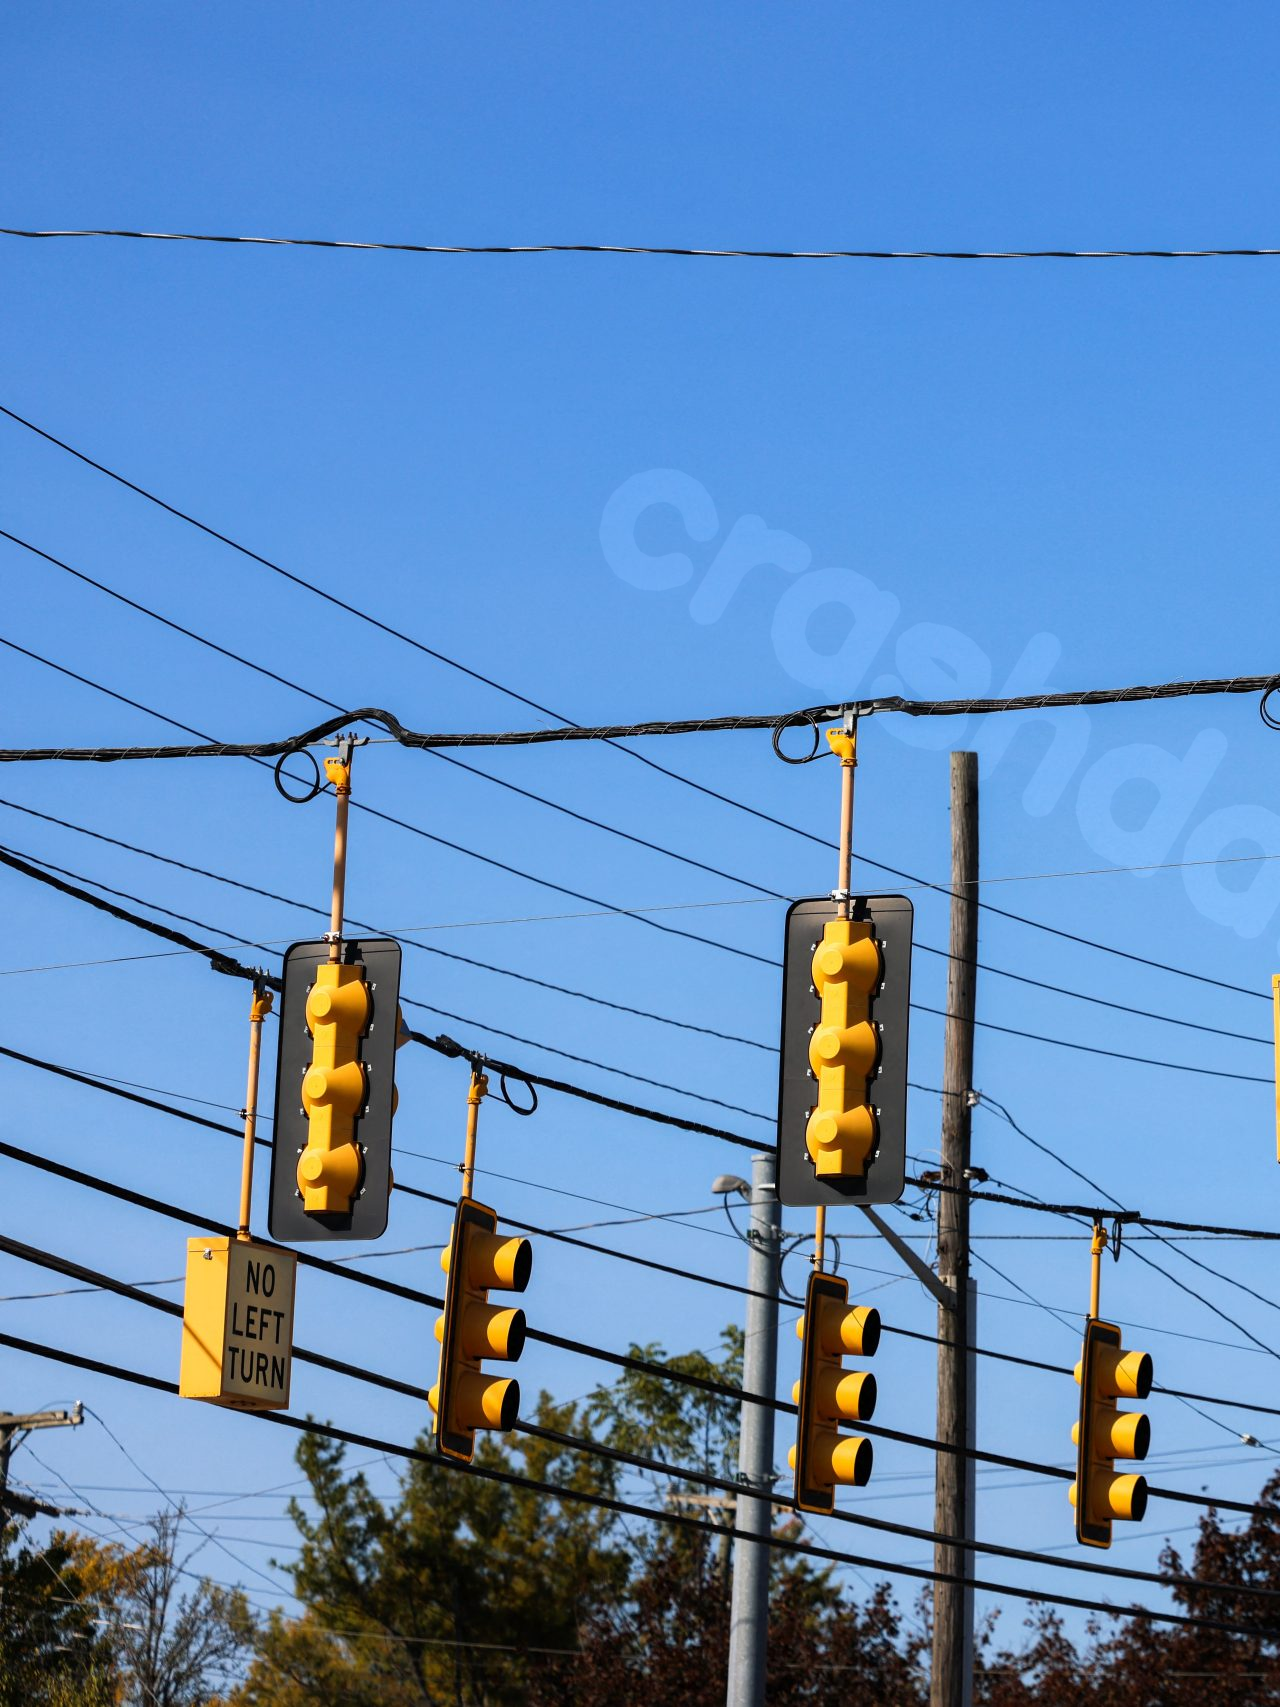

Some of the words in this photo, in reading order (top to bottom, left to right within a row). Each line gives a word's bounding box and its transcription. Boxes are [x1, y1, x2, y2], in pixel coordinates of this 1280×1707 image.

[246, 1260, 276, 1298] NO
[231, 1302, 285, 1344] LEFT
[228, 1346, 286, 1390] TURN
